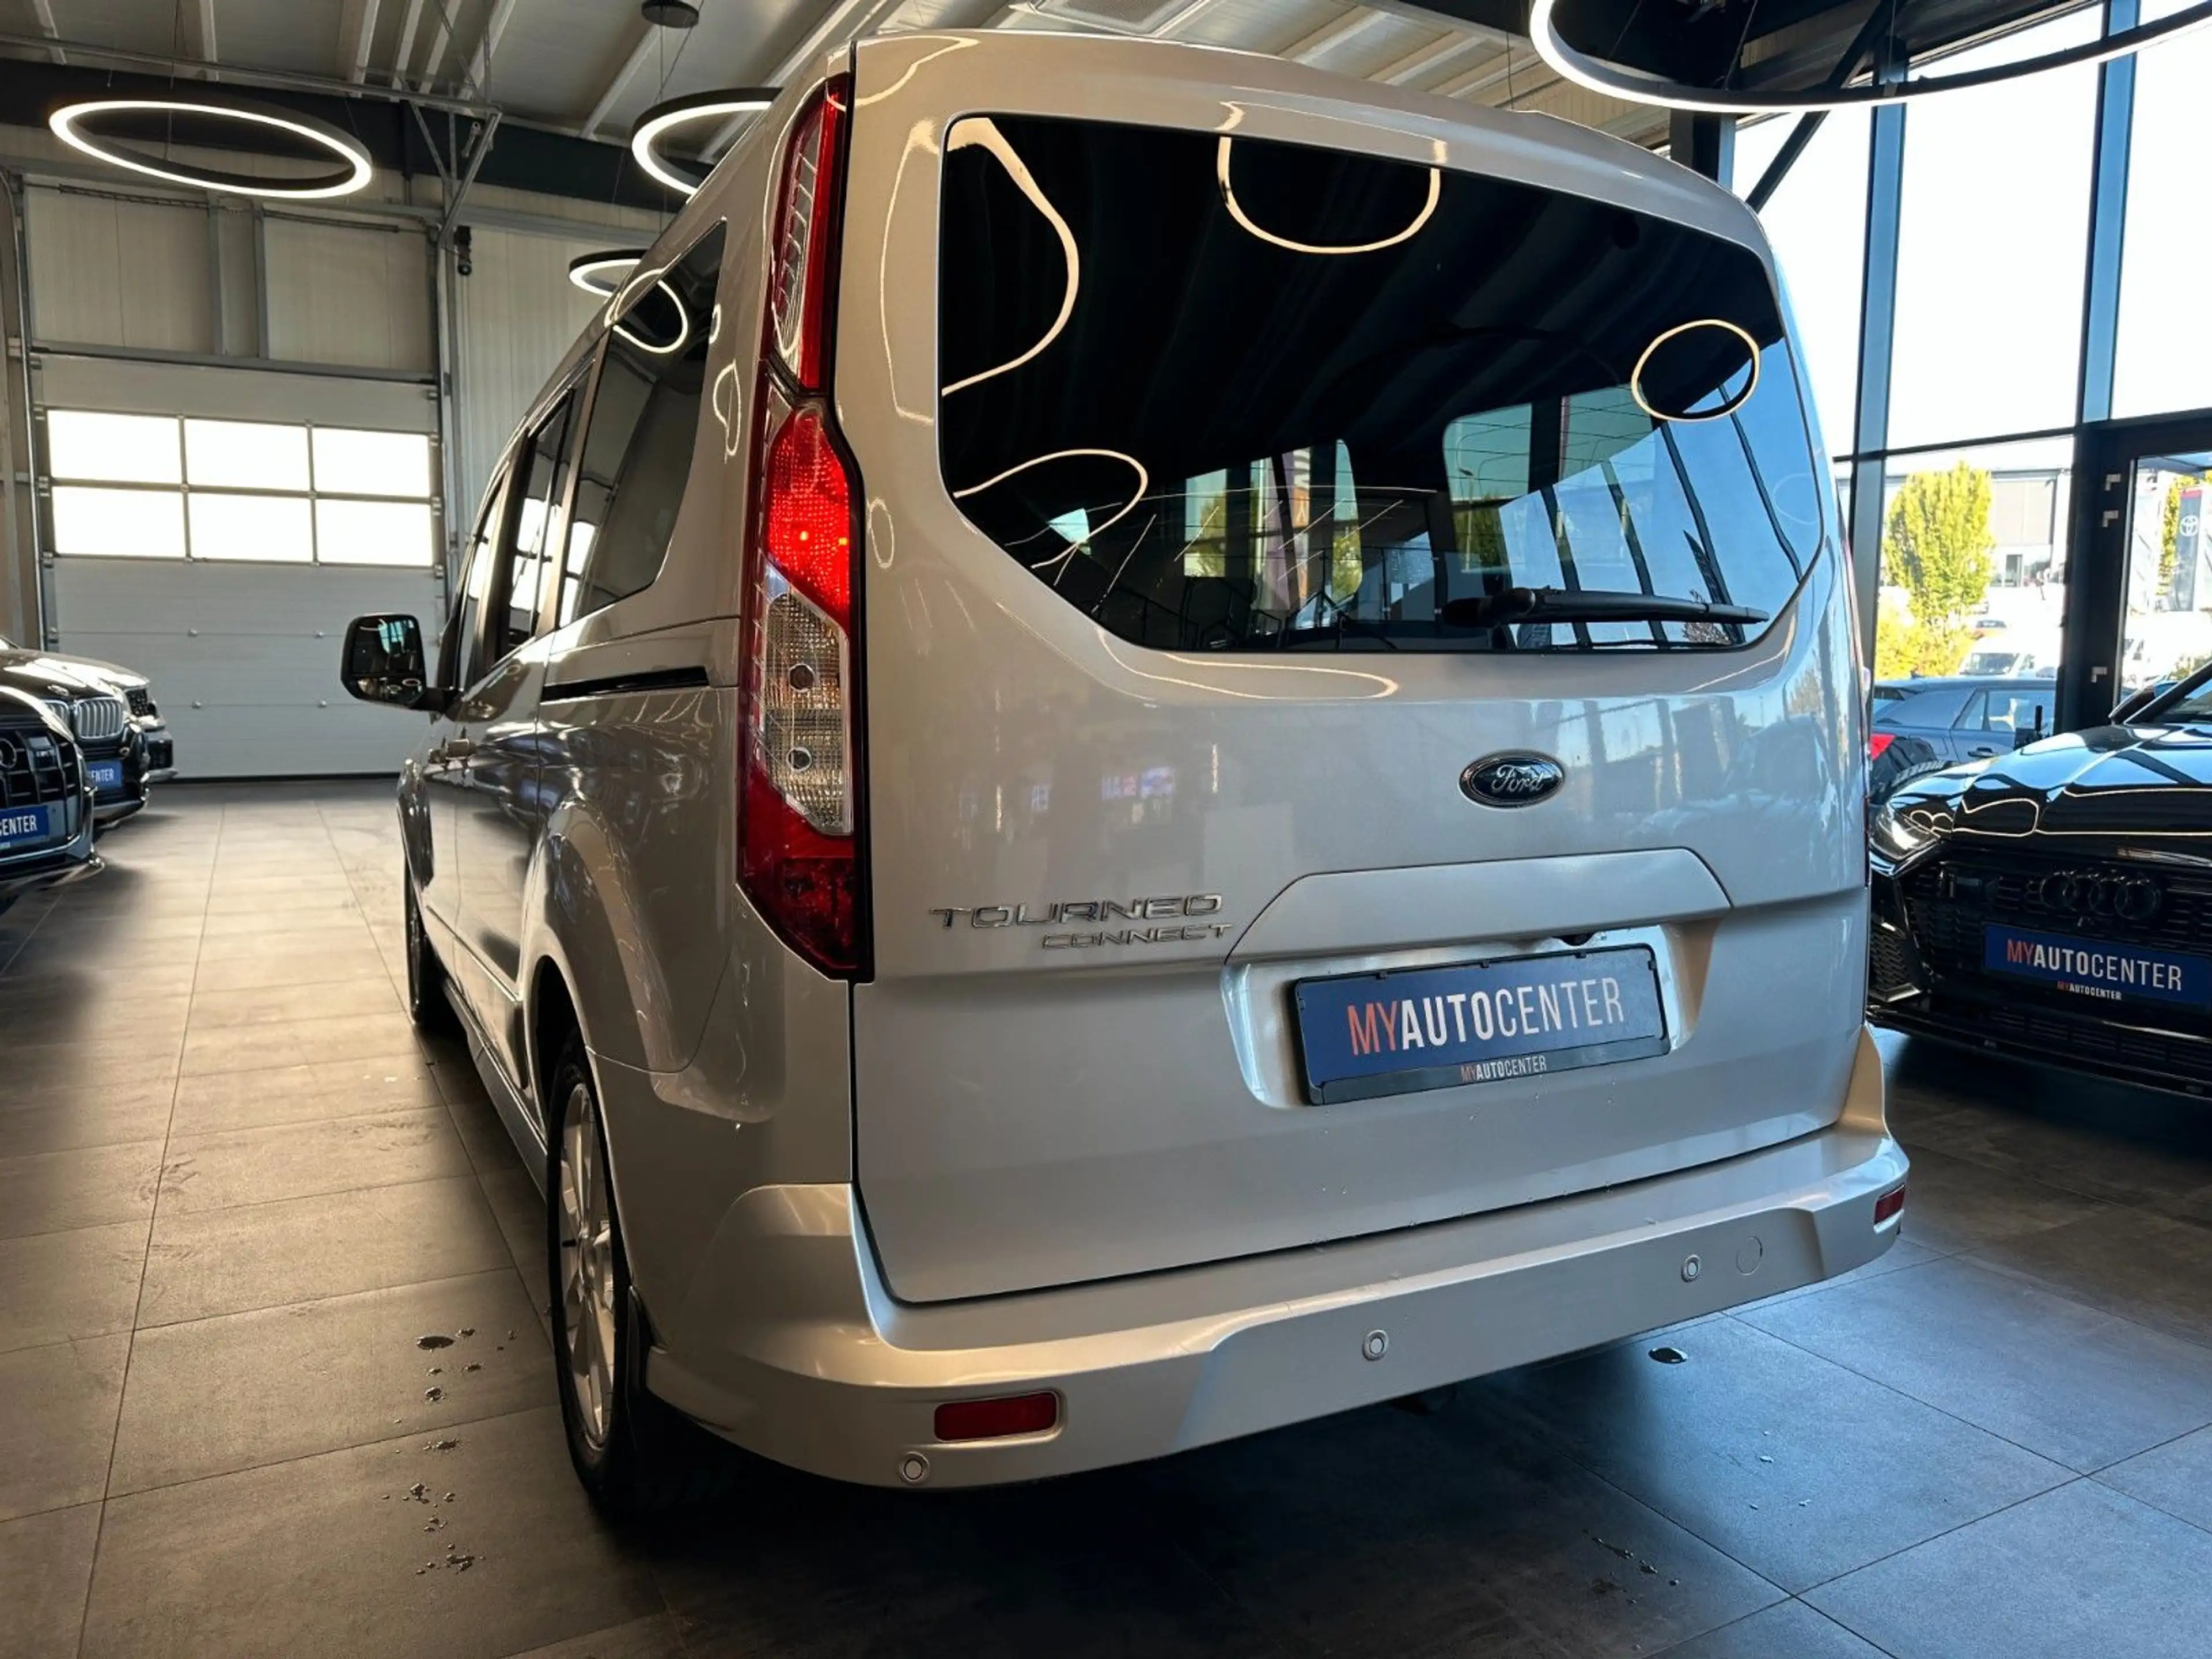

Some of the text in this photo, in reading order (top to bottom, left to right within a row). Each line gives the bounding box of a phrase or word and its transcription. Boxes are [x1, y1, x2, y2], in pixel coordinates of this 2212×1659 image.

[1491, 764, 1544, 793] Ford
[929, 893, 1222, 929] TOURNEO
[1042, 923, 1232, 951] CONNECT
[2006, 938, 2181, 991] MYAUTOCENTER
[1347, 977, 1624, 1056] MYAUTOCENTER
